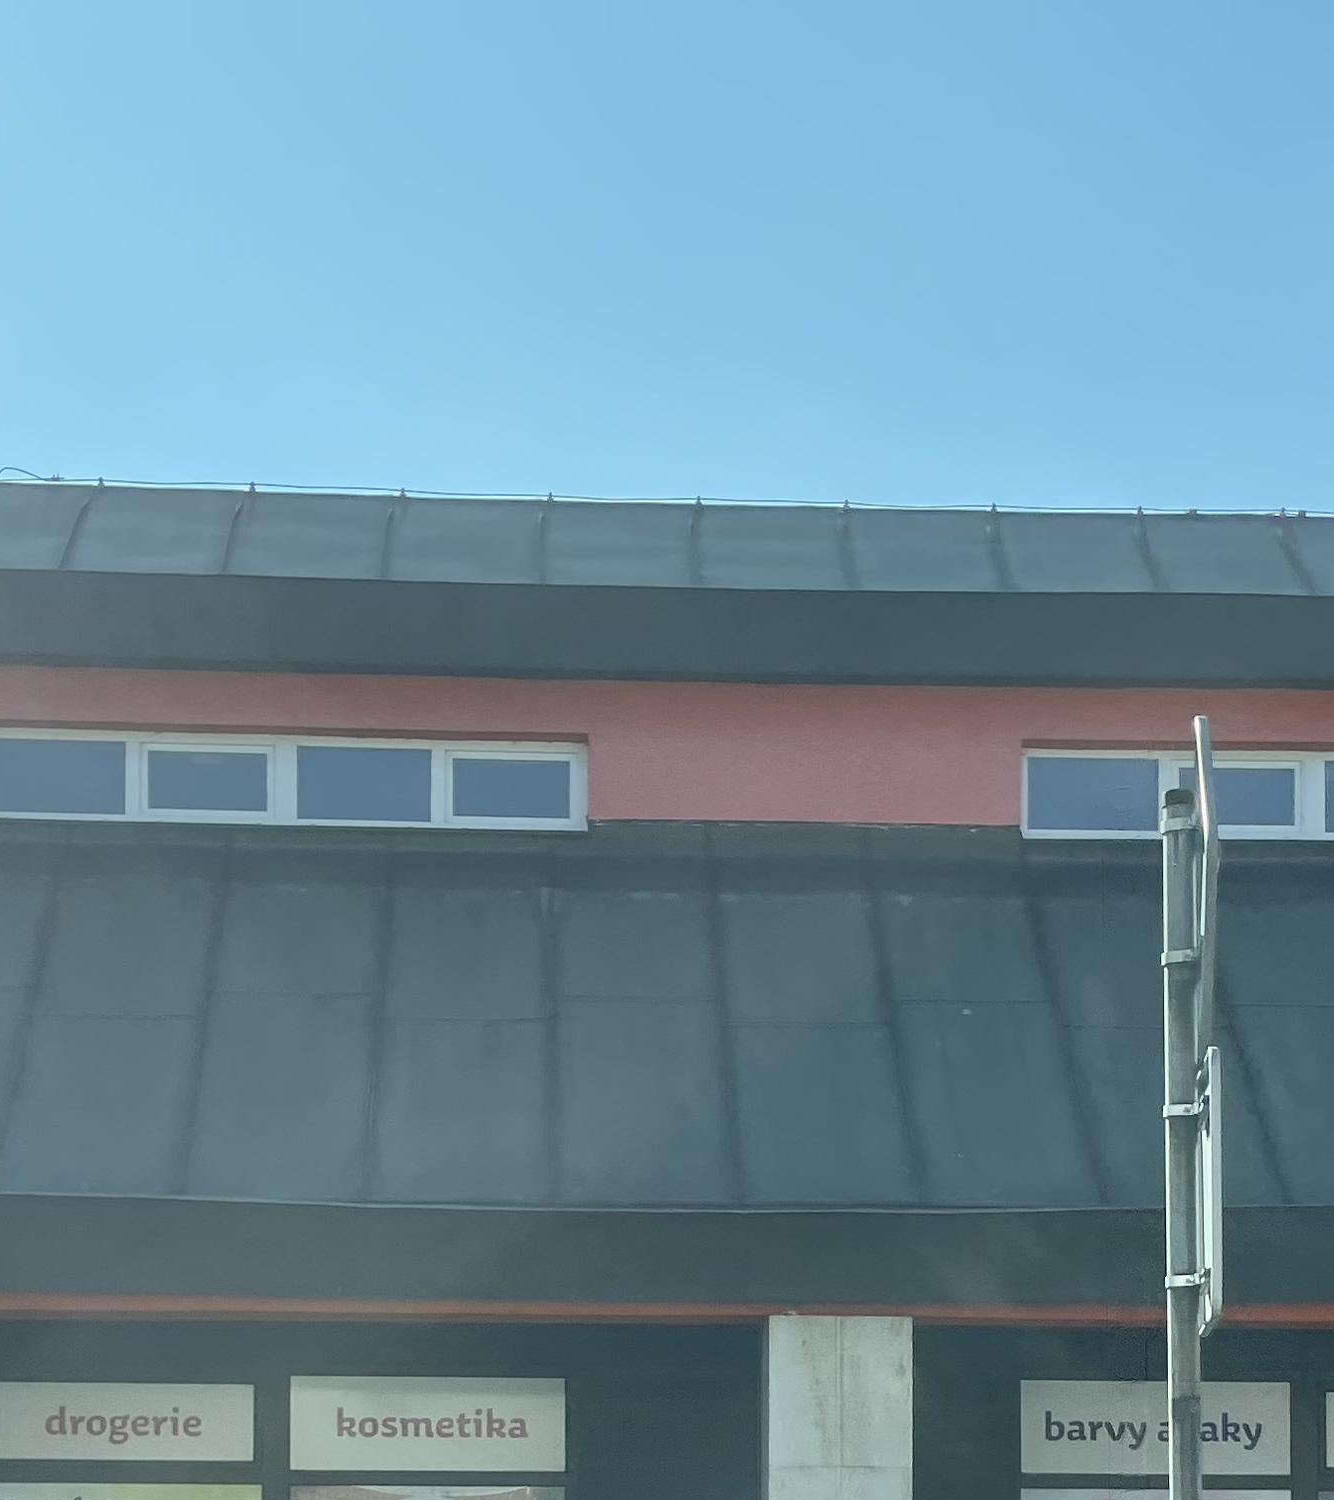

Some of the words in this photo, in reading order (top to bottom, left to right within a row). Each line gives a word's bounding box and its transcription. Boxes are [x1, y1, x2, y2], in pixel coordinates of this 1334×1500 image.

[45, 1406, 203, 1444] drogerie
[336, 1407, 529, 1439] kosmetika
[1045, 1411, 1147, 1450] barvy
[1199, 1413, 1262, 1450] aky
